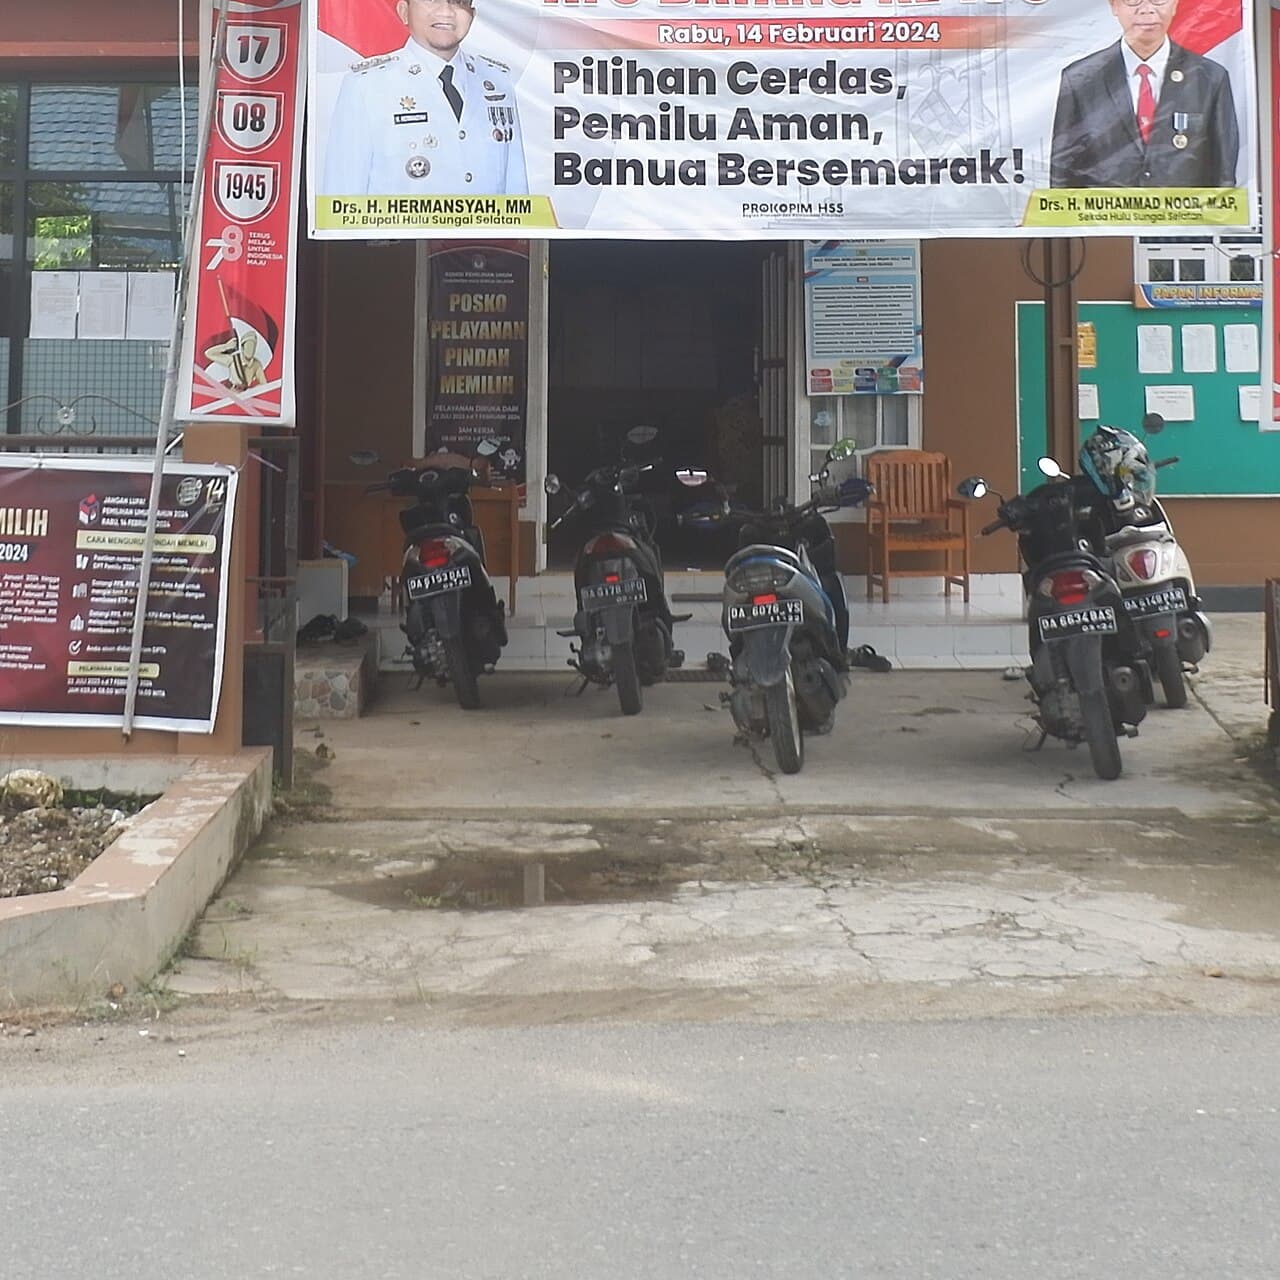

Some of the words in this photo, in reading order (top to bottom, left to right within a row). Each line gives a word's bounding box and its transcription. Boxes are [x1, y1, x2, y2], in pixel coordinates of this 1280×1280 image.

[659, 23, 730, 45] Rabu,
[736, 24, 762, 42] 14
[770, 22, 874, 42] Februari
[881, 23, 940, 42] 2024
[237, 35, 270, 65] 17
[554, 56, 716, 95] Pilihan
[727, 60, 907, 99] Cerdas,
[232, 102, 266, 132] 08
[554, 102, 716, 140] Pemilu
[727, 107, 883, 145] Aman,
[554, 152, 707, 185] Banua
[718, 148, 1025, 186] Bersemarak!
[225, 172, 266, 201] 1945
[332, 200, 362, 214] Drs.
[367, 199, 382, 213] H.
[387, 199, 501, 216] HERMANSYAH,
[505, 199, 532, 213] MM
[742, 203, 813, 213] PROKOPIM
[818, 203, 844, 213] HSS
[1039, 198, 1064, 211] Drs.
[1068, 198, 1081, 210] H.
[1084, 197, 1161, 210] MUHAMMAD
[342, 215, 360, 225] PJ.
[362, 214, 400, 227] Bupati
[405, 215, 429, 225] Hulu
[432, 214, 473, 227] Sungai
[476, 214, 521, 225] Selatan
[1078, 212, 1108, 221] Sekda
[1110, 212, 1132, 221] Hulu
[1134, 212, 1166, 223] Sungai
[1167, 212, 1203, 221] Selatan
[449, 293, 507, 312] POSKO
[1153, 287, 1195, 298] PAPAN
[431, 320, 526, 340] PELAYANAN
[445, 347, 510, 367] PINDAH
[439, 375, 515, 395] MEMILIH
[731, 607, 745, 618] DA
[787, 602, 800, 613] VS
[1041, 619, 1058, 630] DA
